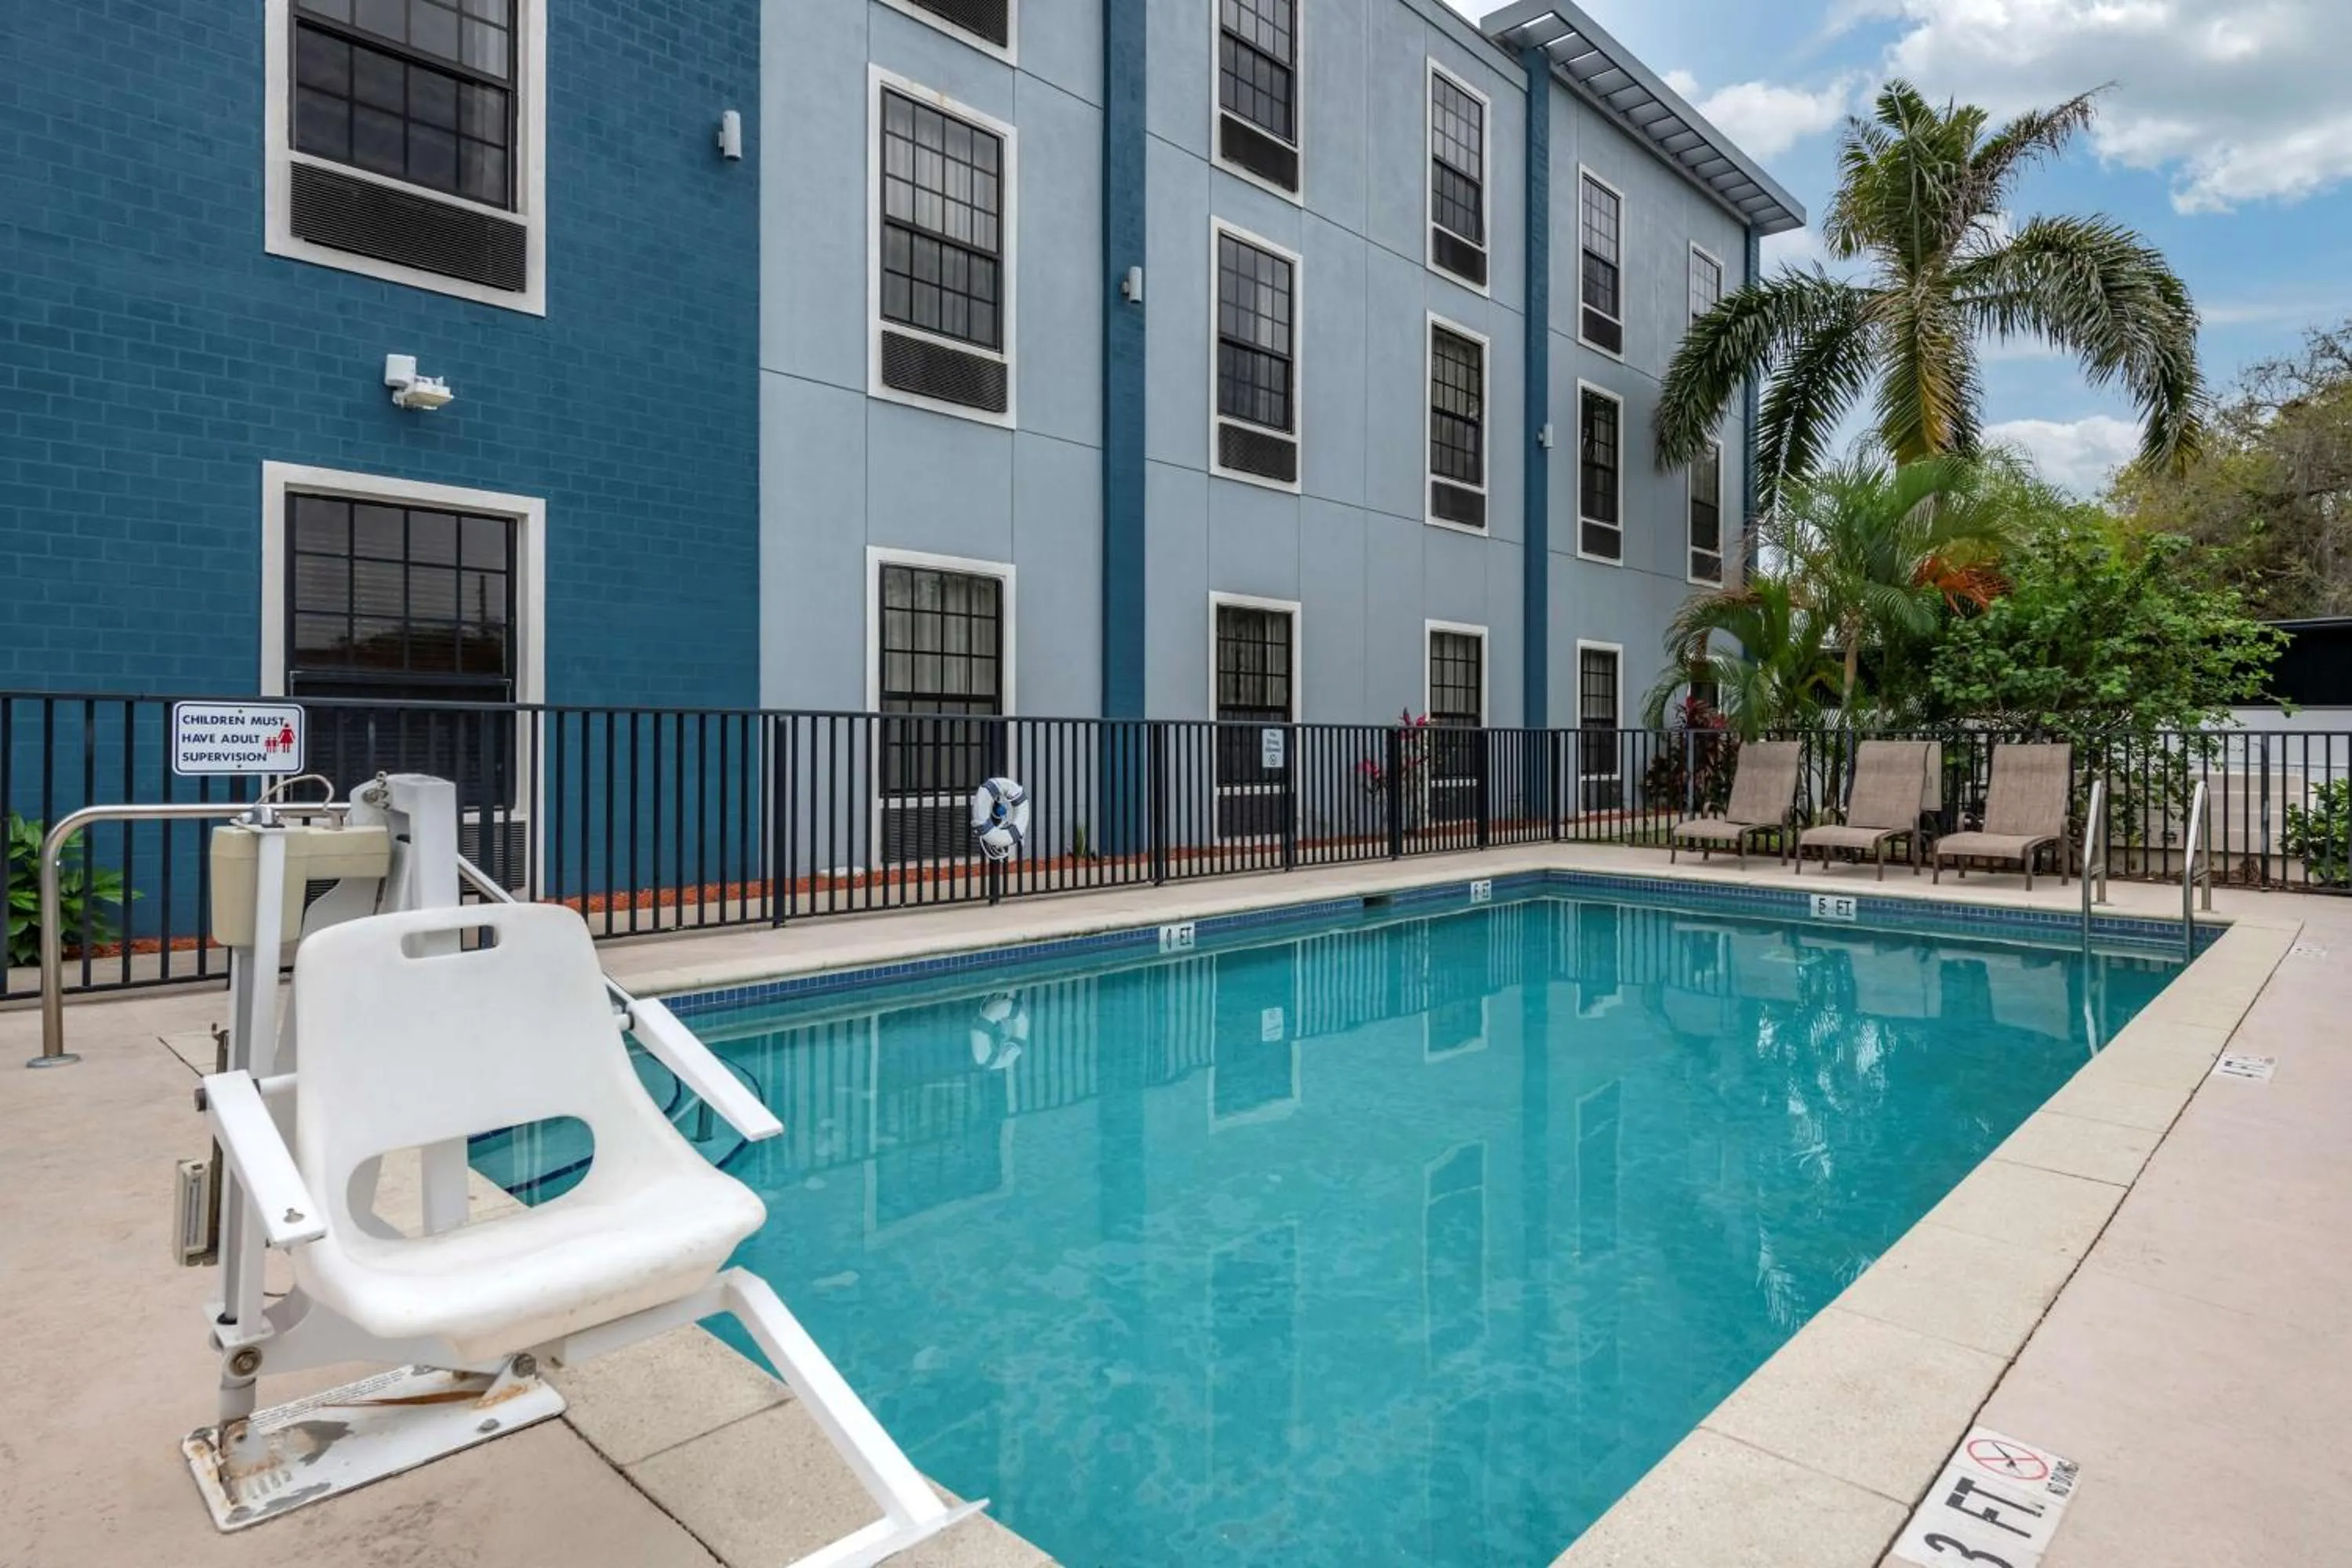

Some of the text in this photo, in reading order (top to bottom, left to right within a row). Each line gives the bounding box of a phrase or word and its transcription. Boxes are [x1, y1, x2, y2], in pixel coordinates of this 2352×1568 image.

[183, 714, 285, 726] CHILDREN MUST
[182, 734, 261, 745] HAVE ADULT
[182, 752, 267, 762] SUPERVISION
[1924, 1533, 2013, 1568] 3
